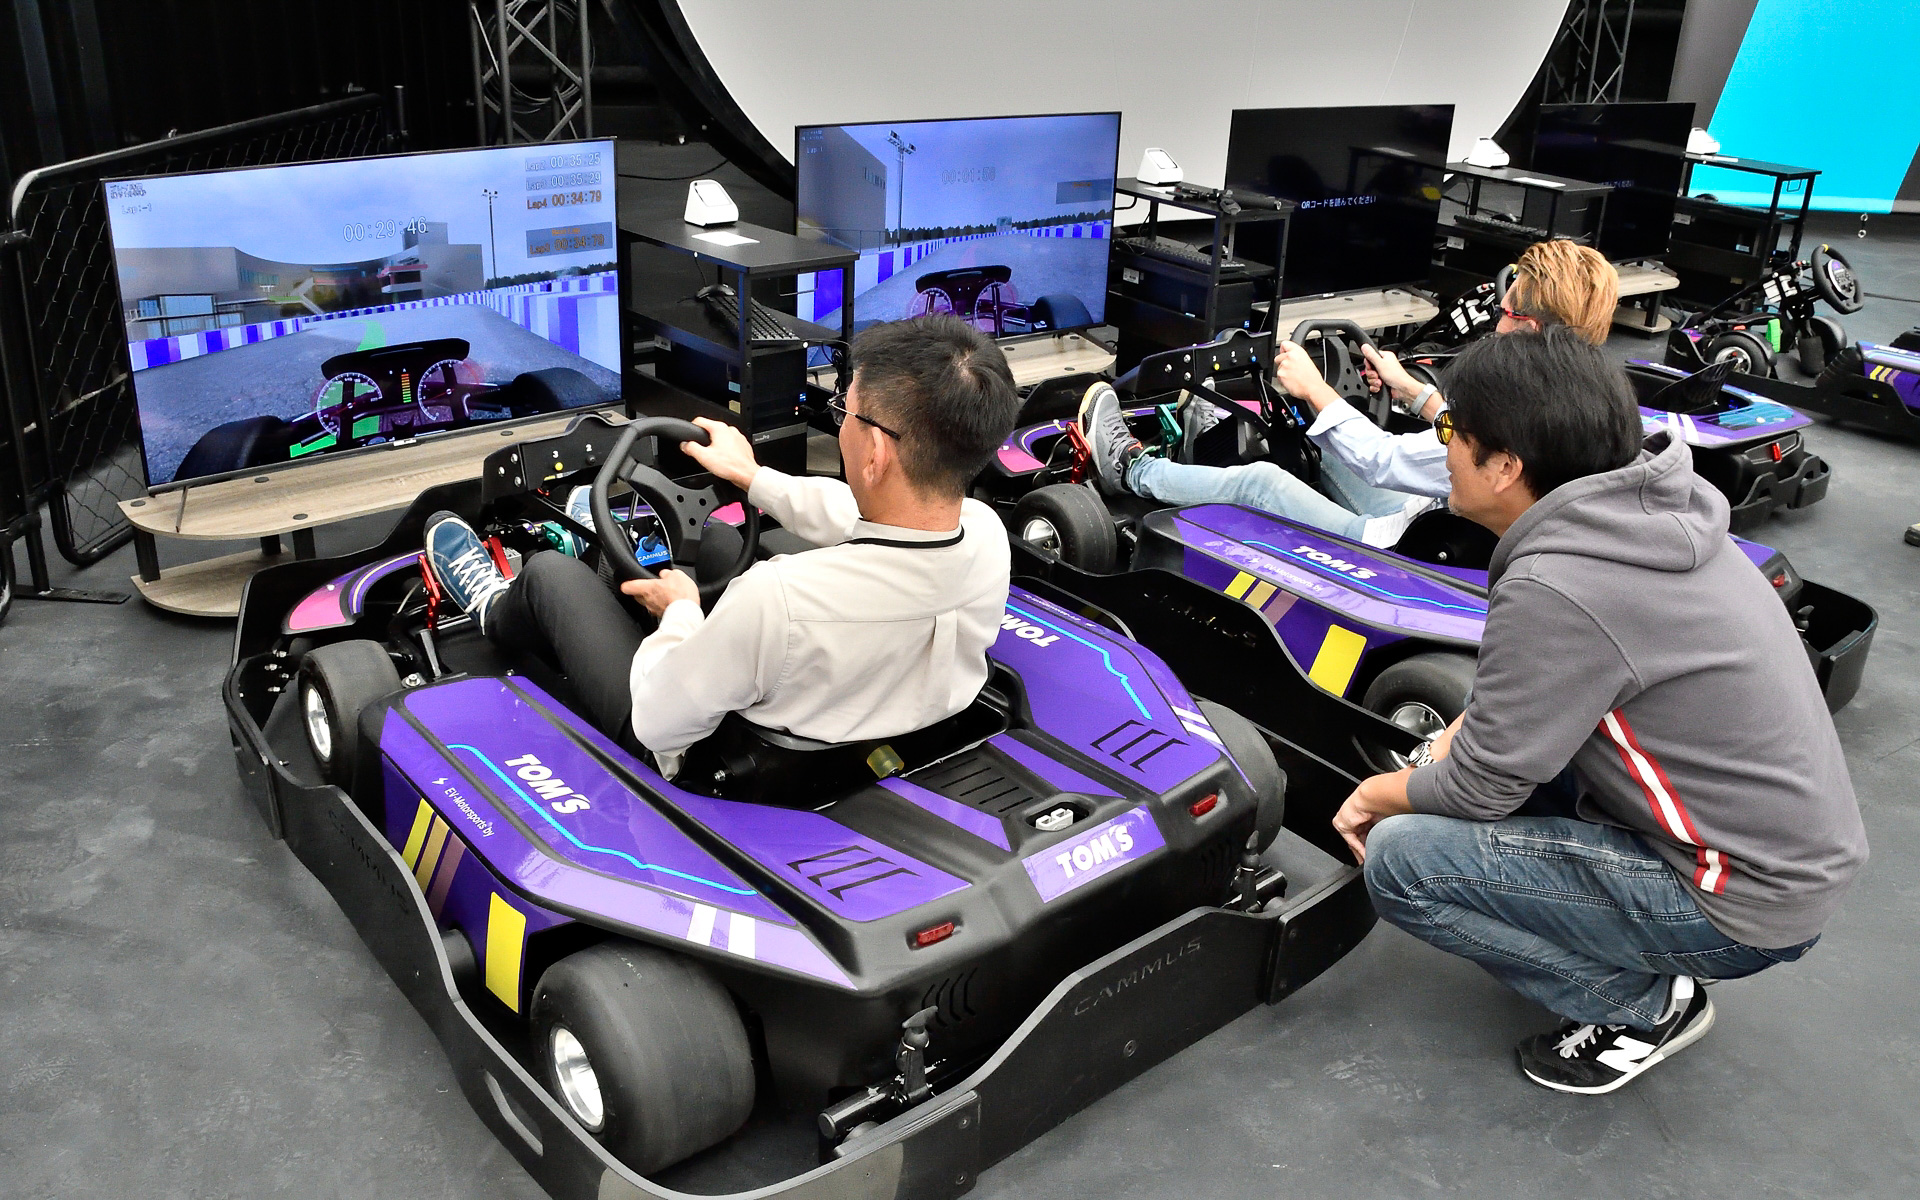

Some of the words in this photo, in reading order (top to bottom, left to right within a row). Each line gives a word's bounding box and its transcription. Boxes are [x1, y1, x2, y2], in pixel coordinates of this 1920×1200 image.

[550, 152, 601, 168] 00:35:25
[551, 171, 601, 188] 00:35:29
[527, 197, 548, 210] Lap4
[343, 216, 427, 242] 00:29:46
[552, 450, 559, 459] 3
[585, 443, 593, 452] 2
[637, 550, 668, 562] CAMMUS
[504, 753, 591, 815] TOM'S
[444, 787, 487, 830] EV-Motorsports
[483, 826, 495, 837] by
[1055, 823, 1134, 879] TOM'S
[1073, 936, 1203, 1017] CAMMUS
